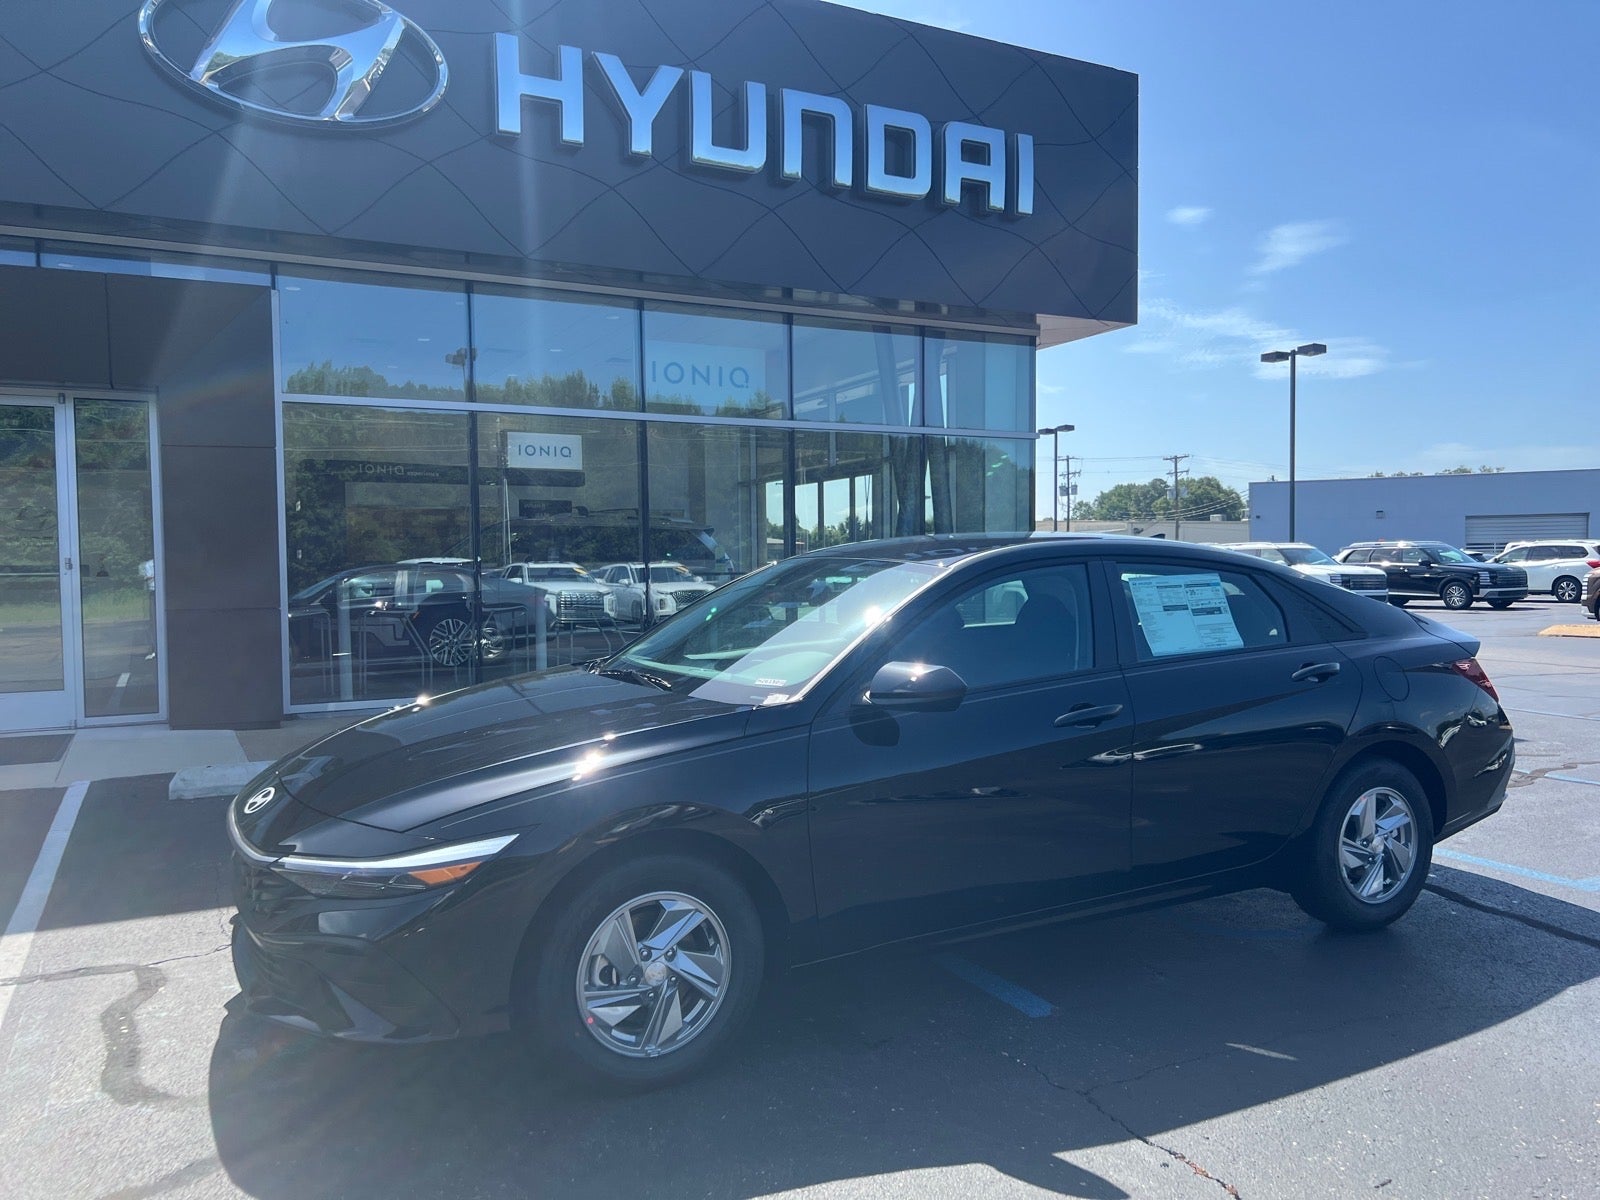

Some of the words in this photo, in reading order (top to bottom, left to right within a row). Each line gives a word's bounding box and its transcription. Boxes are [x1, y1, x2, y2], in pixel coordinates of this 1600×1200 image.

[493, 32, 1034, 216] HYUNDAI
[651, 360, 750, 389] IONIQ
[518, 444, 572, 458] IONIQ
[359, 463, 405, 476] IONIQ
